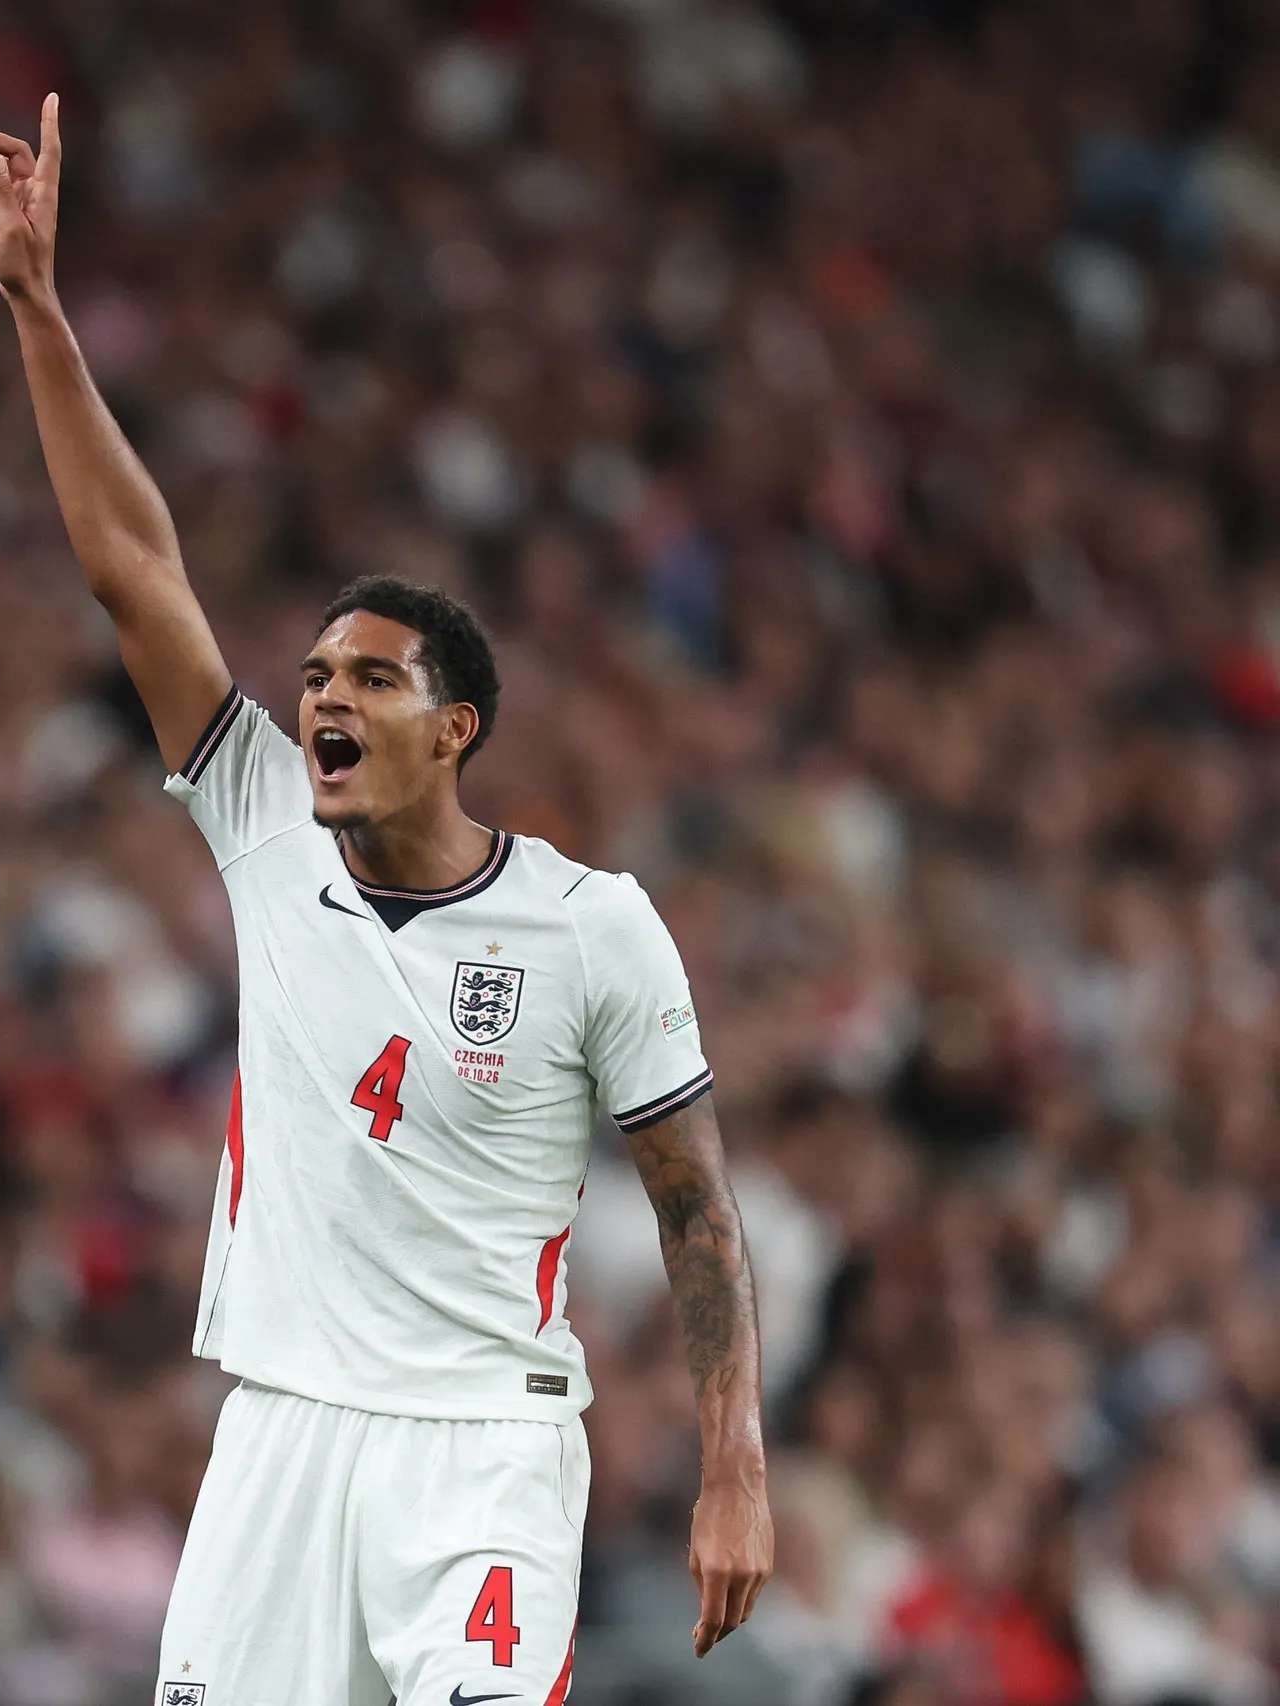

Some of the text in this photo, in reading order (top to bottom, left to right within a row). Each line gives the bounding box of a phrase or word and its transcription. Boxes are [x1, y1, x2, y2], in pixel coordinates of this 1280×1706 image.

[661, 1007, 677, 1020] UEFA
[454, 1049, 504, 1067] CZECHIA
[457, 1066, 499, 1084] 06.10.26
[350, 1034, 412, 1142] 4
[465, 1566, 520, 1668] 4
